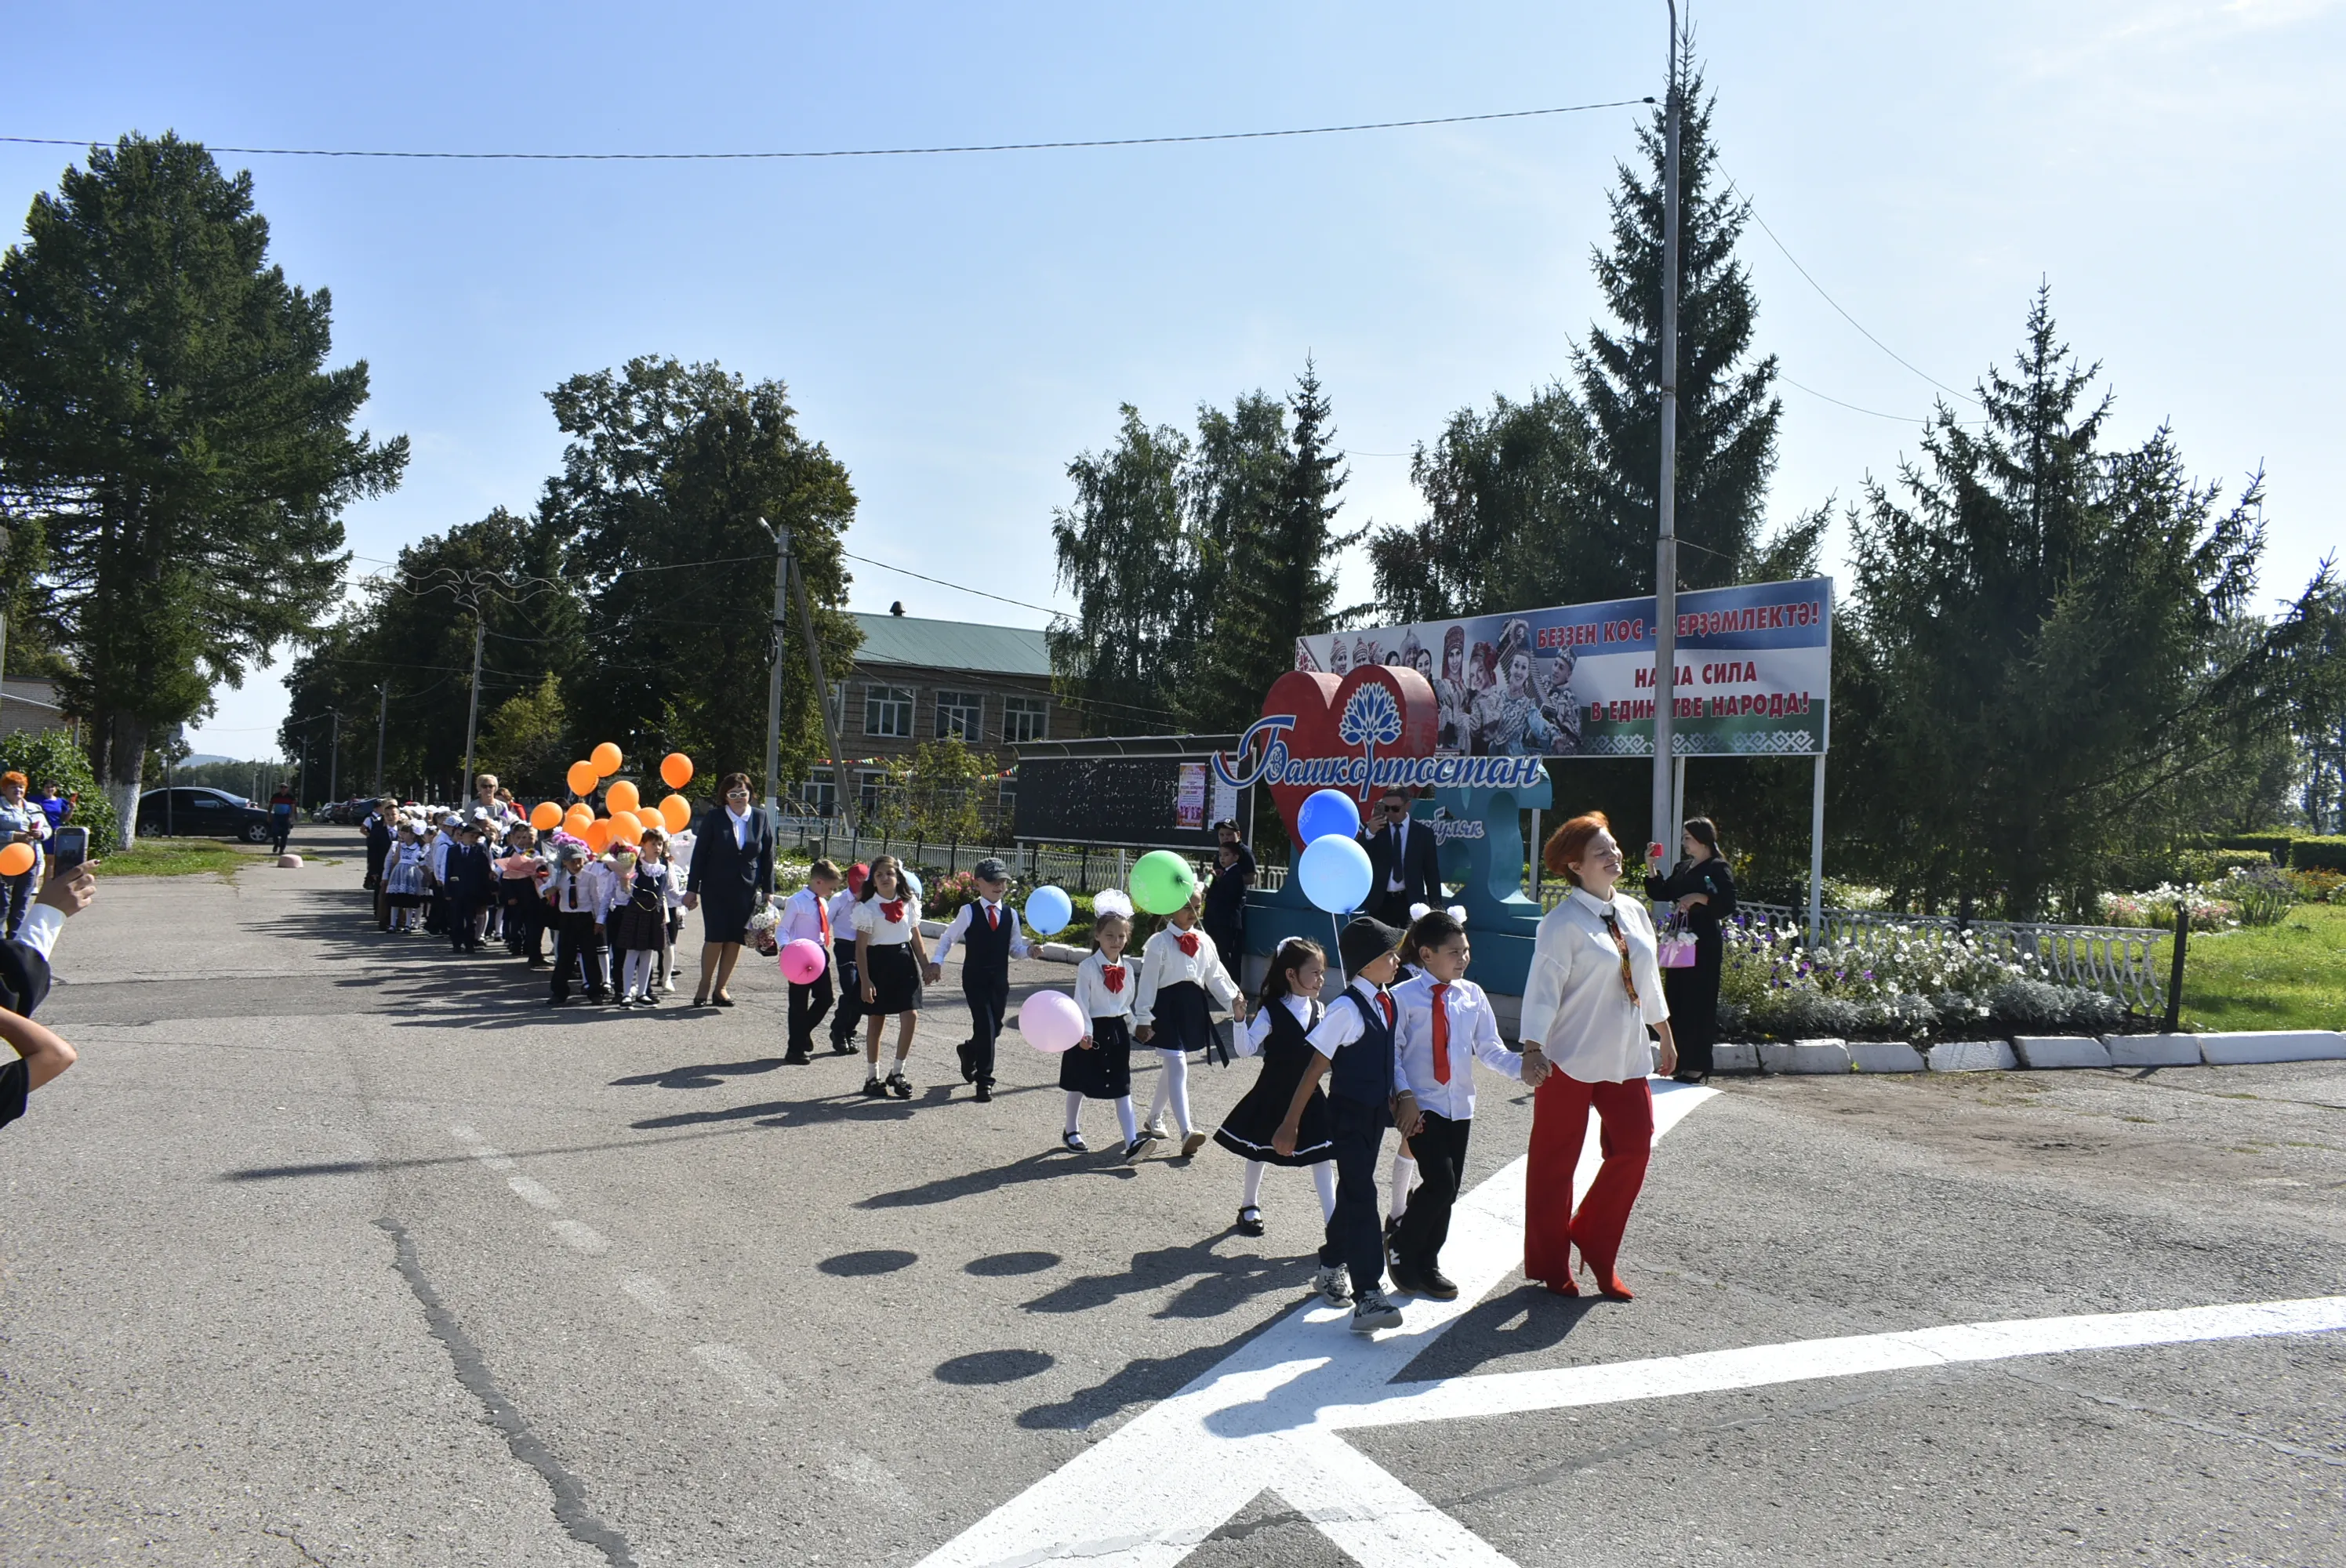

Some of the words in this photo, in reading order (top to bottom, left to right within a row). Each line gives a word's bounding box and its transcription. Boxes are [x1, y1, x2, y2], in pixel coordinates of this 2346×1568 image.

[1674, 601, 1819, 638] ЕРҘӘМЛЕКТӘ!
[1701, 661, 1757, 685] СИЛА
[1590, 701, 1602, 721] В
[1609, 697, 1703, 724] ЕДИНТВЕ
[1711, 691, 1809, 719] НАРОДА!
[1211, 714, 1543, 802] Башкортостан
